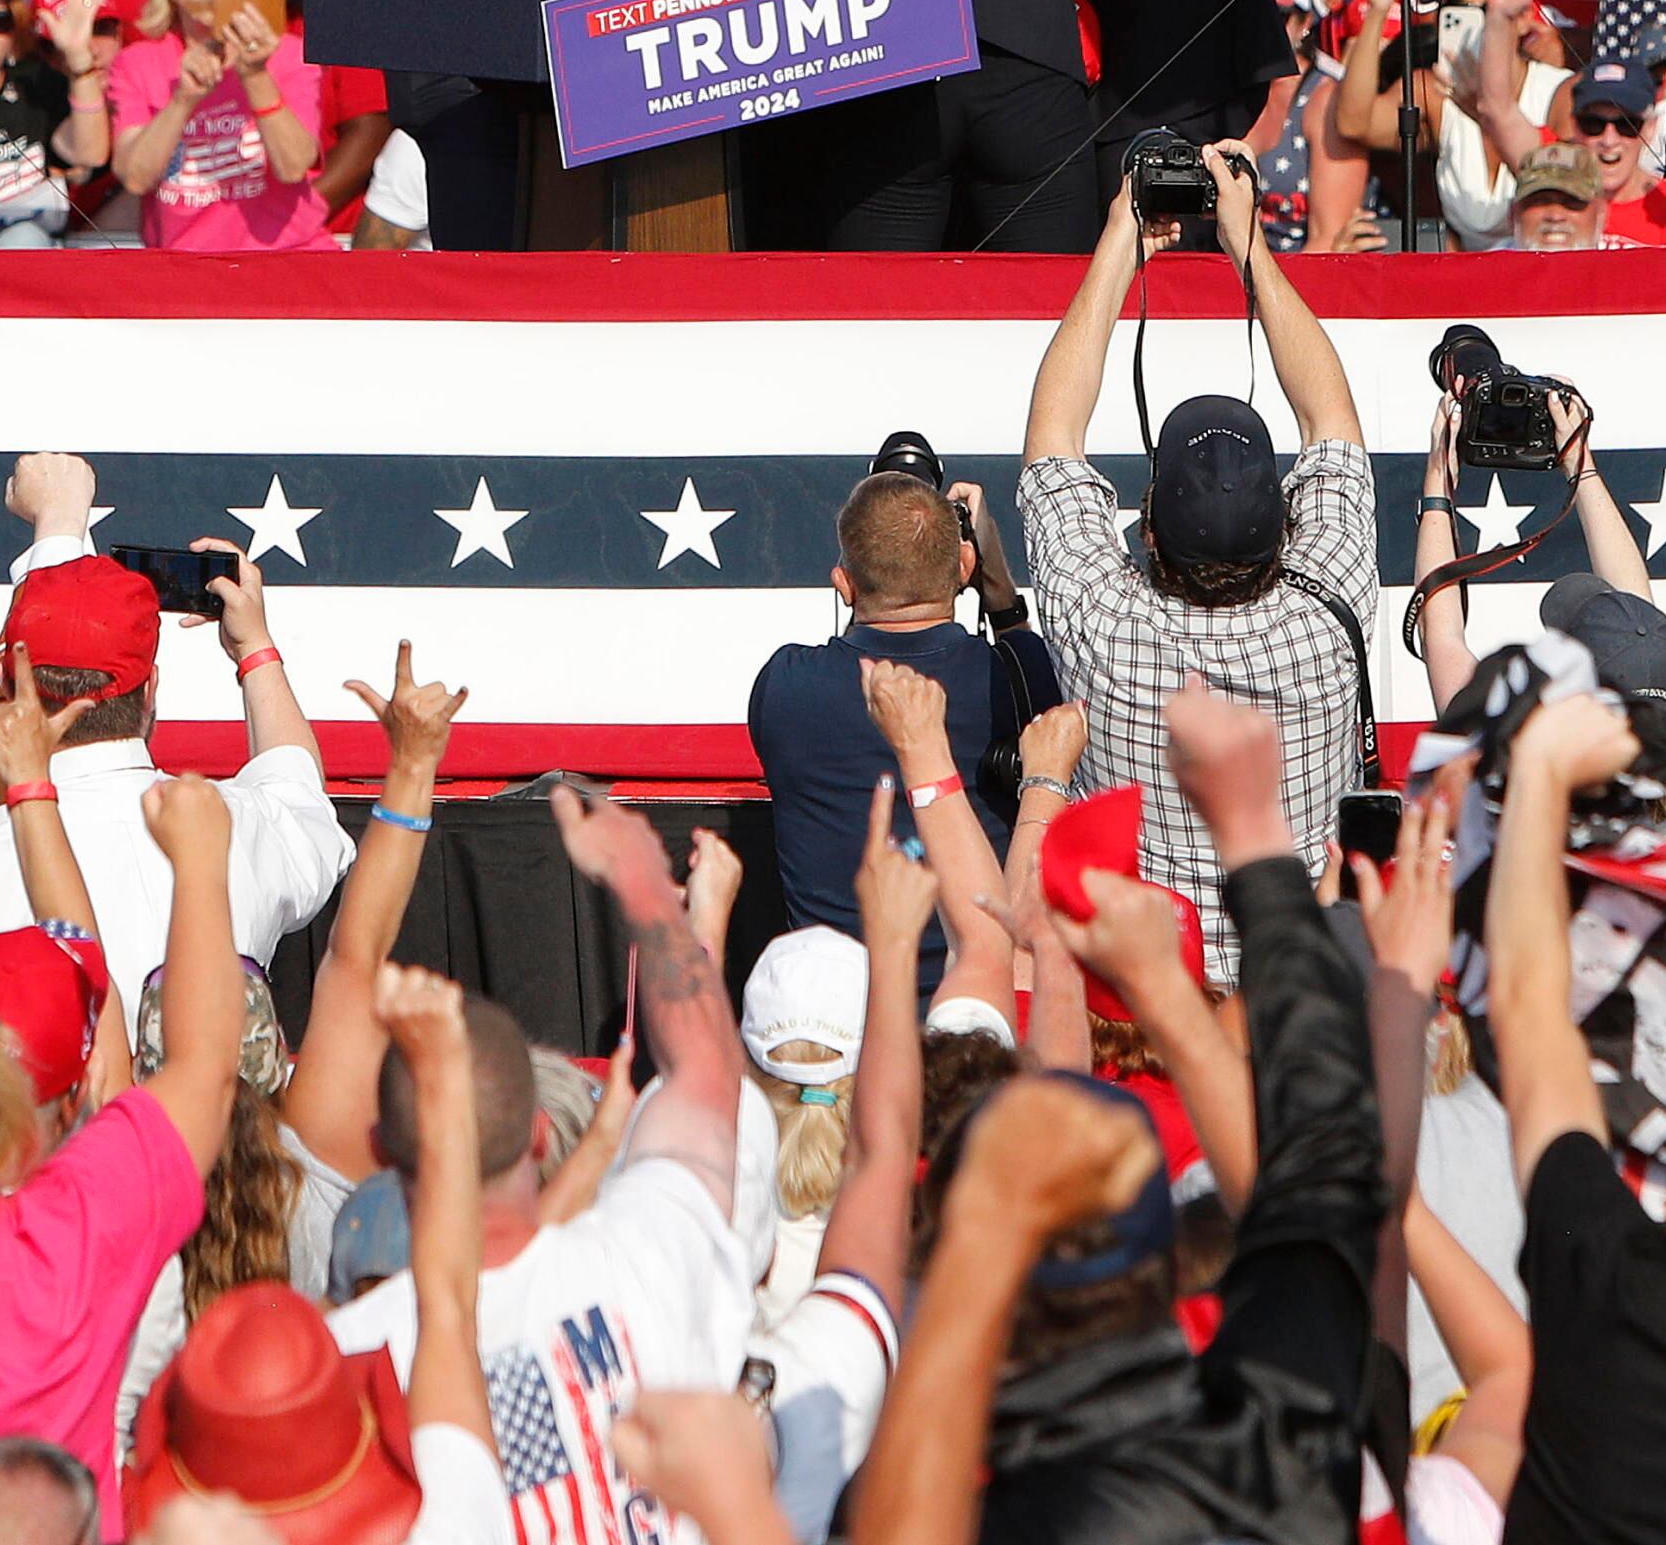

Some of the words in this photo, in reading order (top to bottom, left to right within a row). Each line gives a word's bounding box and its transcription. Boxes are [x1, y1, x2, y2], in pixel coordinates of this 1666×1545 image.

[595, 3, 649, 35] TEXT
[647, 91, 694, 116] MAKE
[696, 74, 771, 104] AMERICA
[773, 58, 826, 84] GREAT
[828, 44, 885, 72] AGAIN!
[739, 87, 802, 122] 2024
[1405, 591, 1425, 643] Canon
